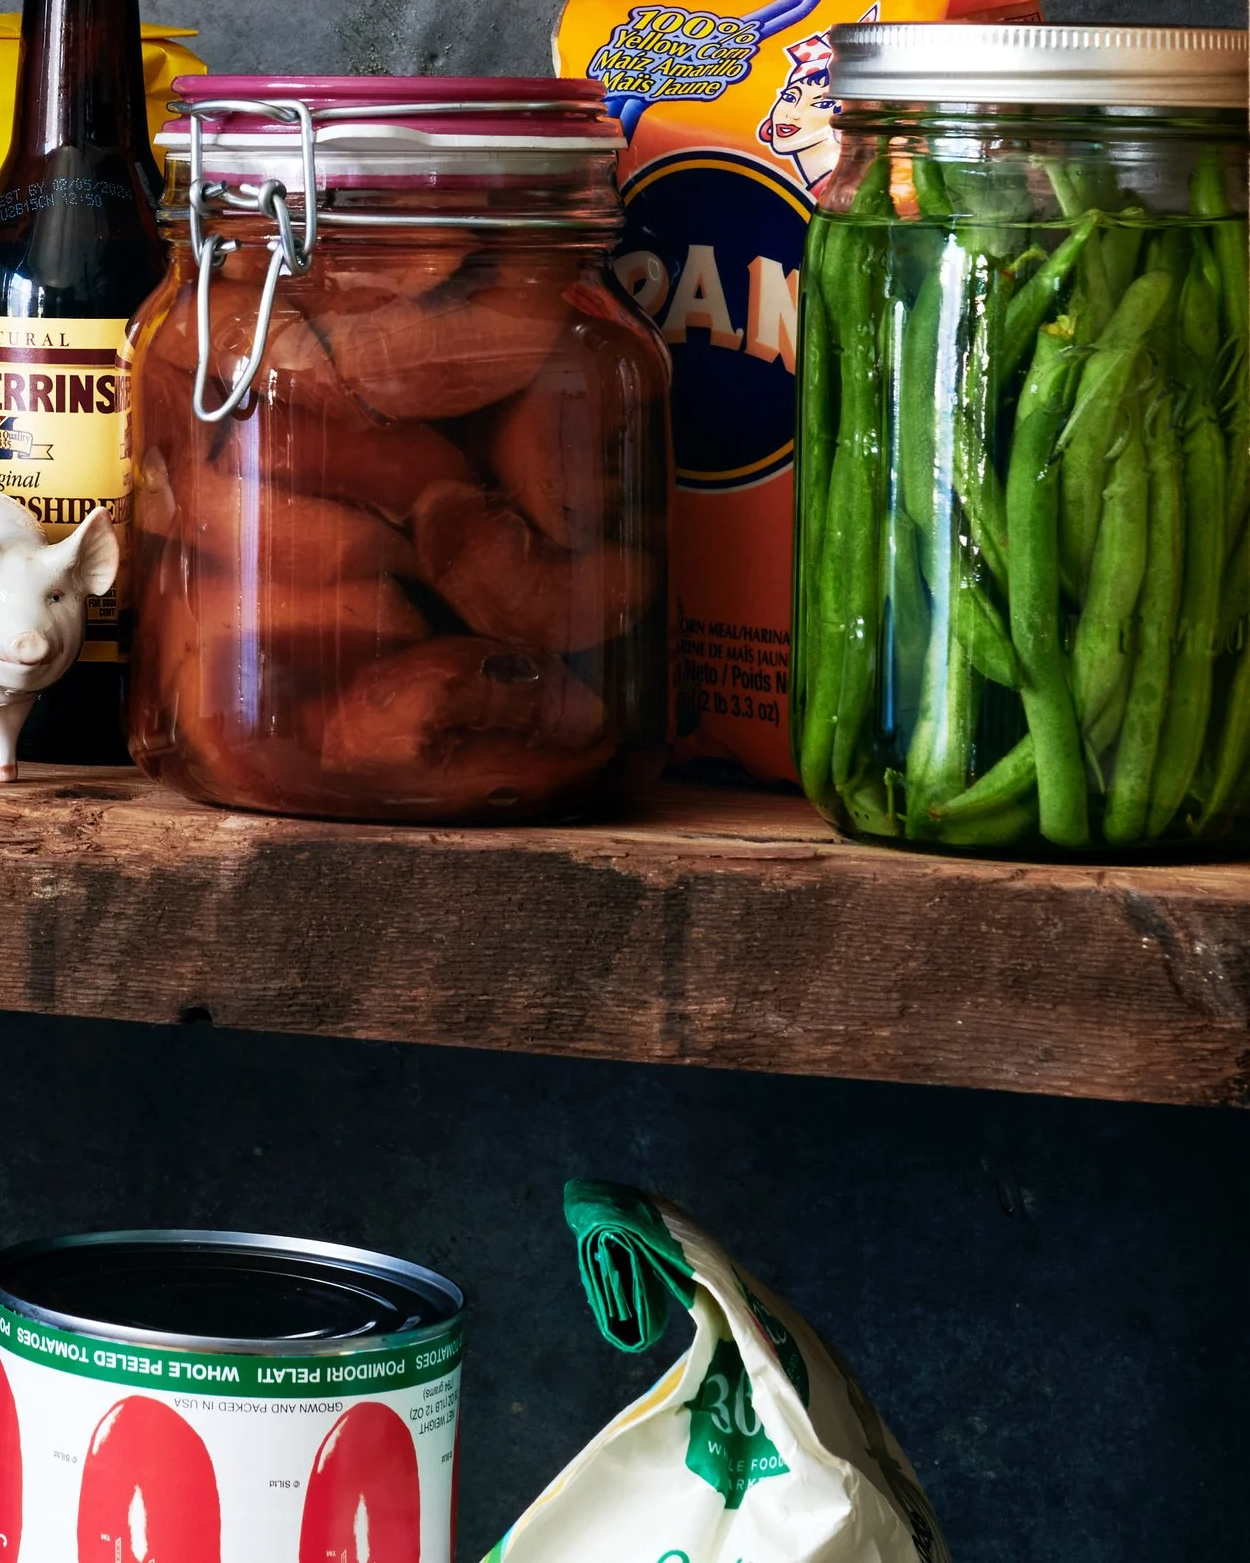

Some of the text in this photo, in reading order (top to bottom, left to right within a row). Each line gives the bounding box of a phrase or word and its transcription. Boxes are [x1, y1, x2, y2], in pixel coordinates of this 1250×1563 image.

[633, 9, 756, 45] 100%
[614, 29, 752, 61] Yellow Corn
[593, 49, 744, 79] Maíz Amarillo
[600, 71, 722, 99] Maïs Jaune
[27, 180, 47, 197] BY
[61, 193, 104, 208] 12:50
[709, 644, 725, 661] DE
[686, 660, 719, 687] Neto
[732, 666, 774, 695] Poids
[715, 692, 729, 717] lb
[732, 695, 756, 722] 3.3
[759, 702, 782, 730] oz)
[16, 1327, 240, 1383] WHOLE PEELED TOMATOES
[257, 1359, 405, 1384] POMIDORI PELATI
[422, 1380, 444, 1401] grams)
[173, 1397, 343, 1414] GROWN AND PACKED IN USA
[410, 1407, 424, 1421] OZ)
[425, 1404, 433, 1416] 12
[418, 1414, 446, 1435] WEIGHT
